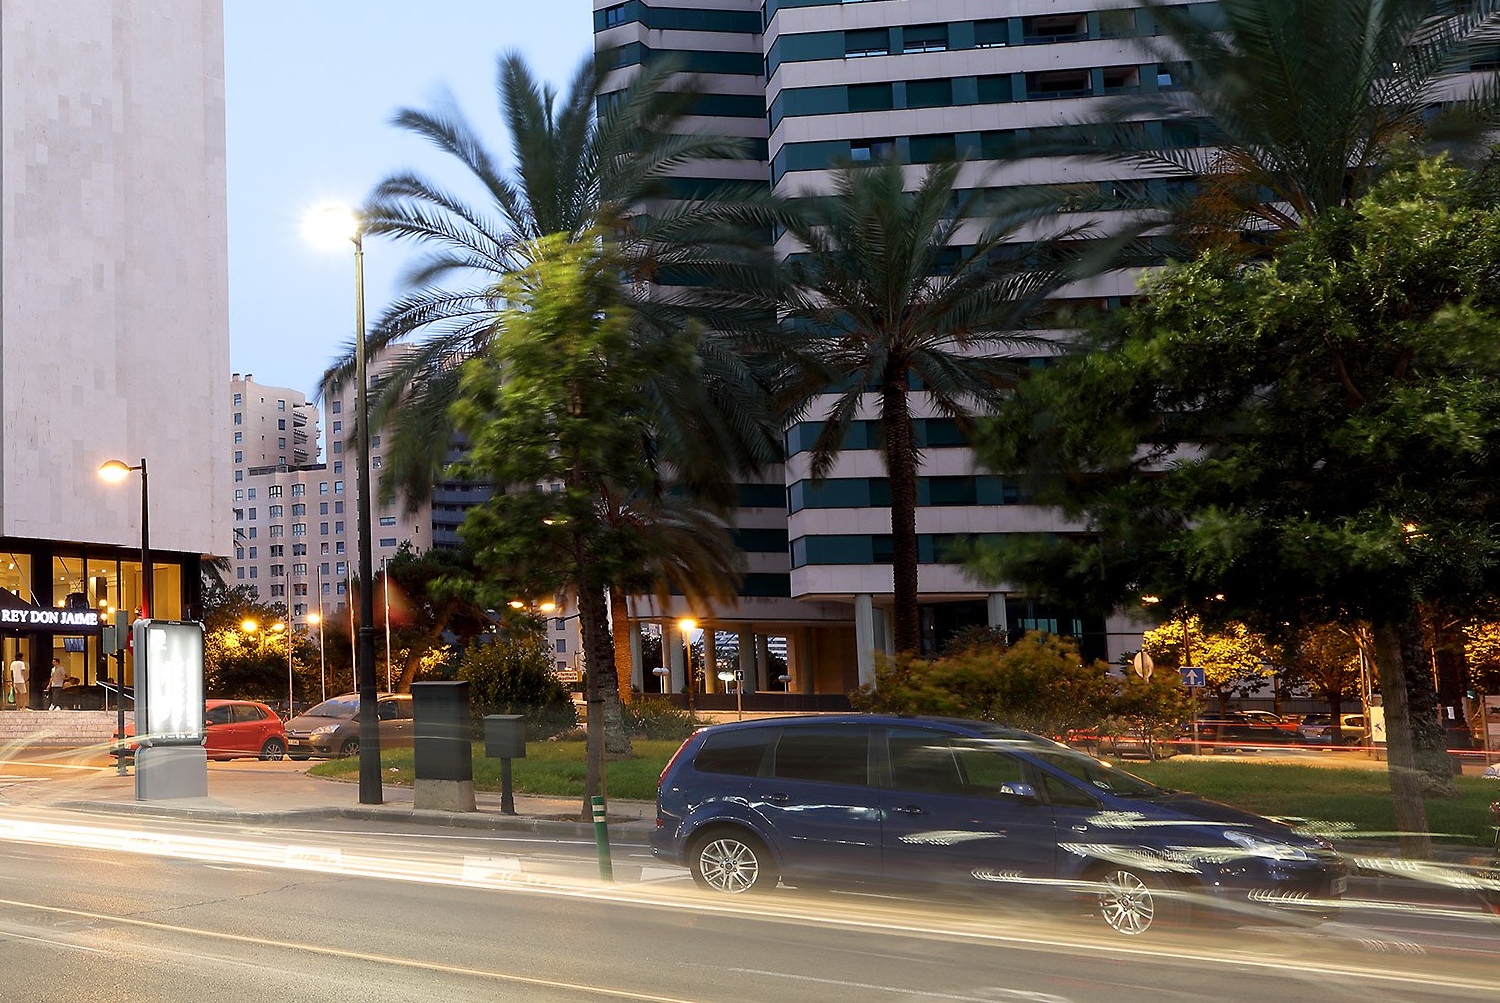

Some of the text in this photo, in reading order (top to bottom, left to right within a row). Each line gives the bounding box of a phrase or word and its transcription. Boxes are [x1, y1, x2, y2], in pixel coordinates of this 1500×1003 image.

[2, 609, 30, 623] REY
[30, 611, 58, 624] DON
[61, 612, 98, 625] JAIME
